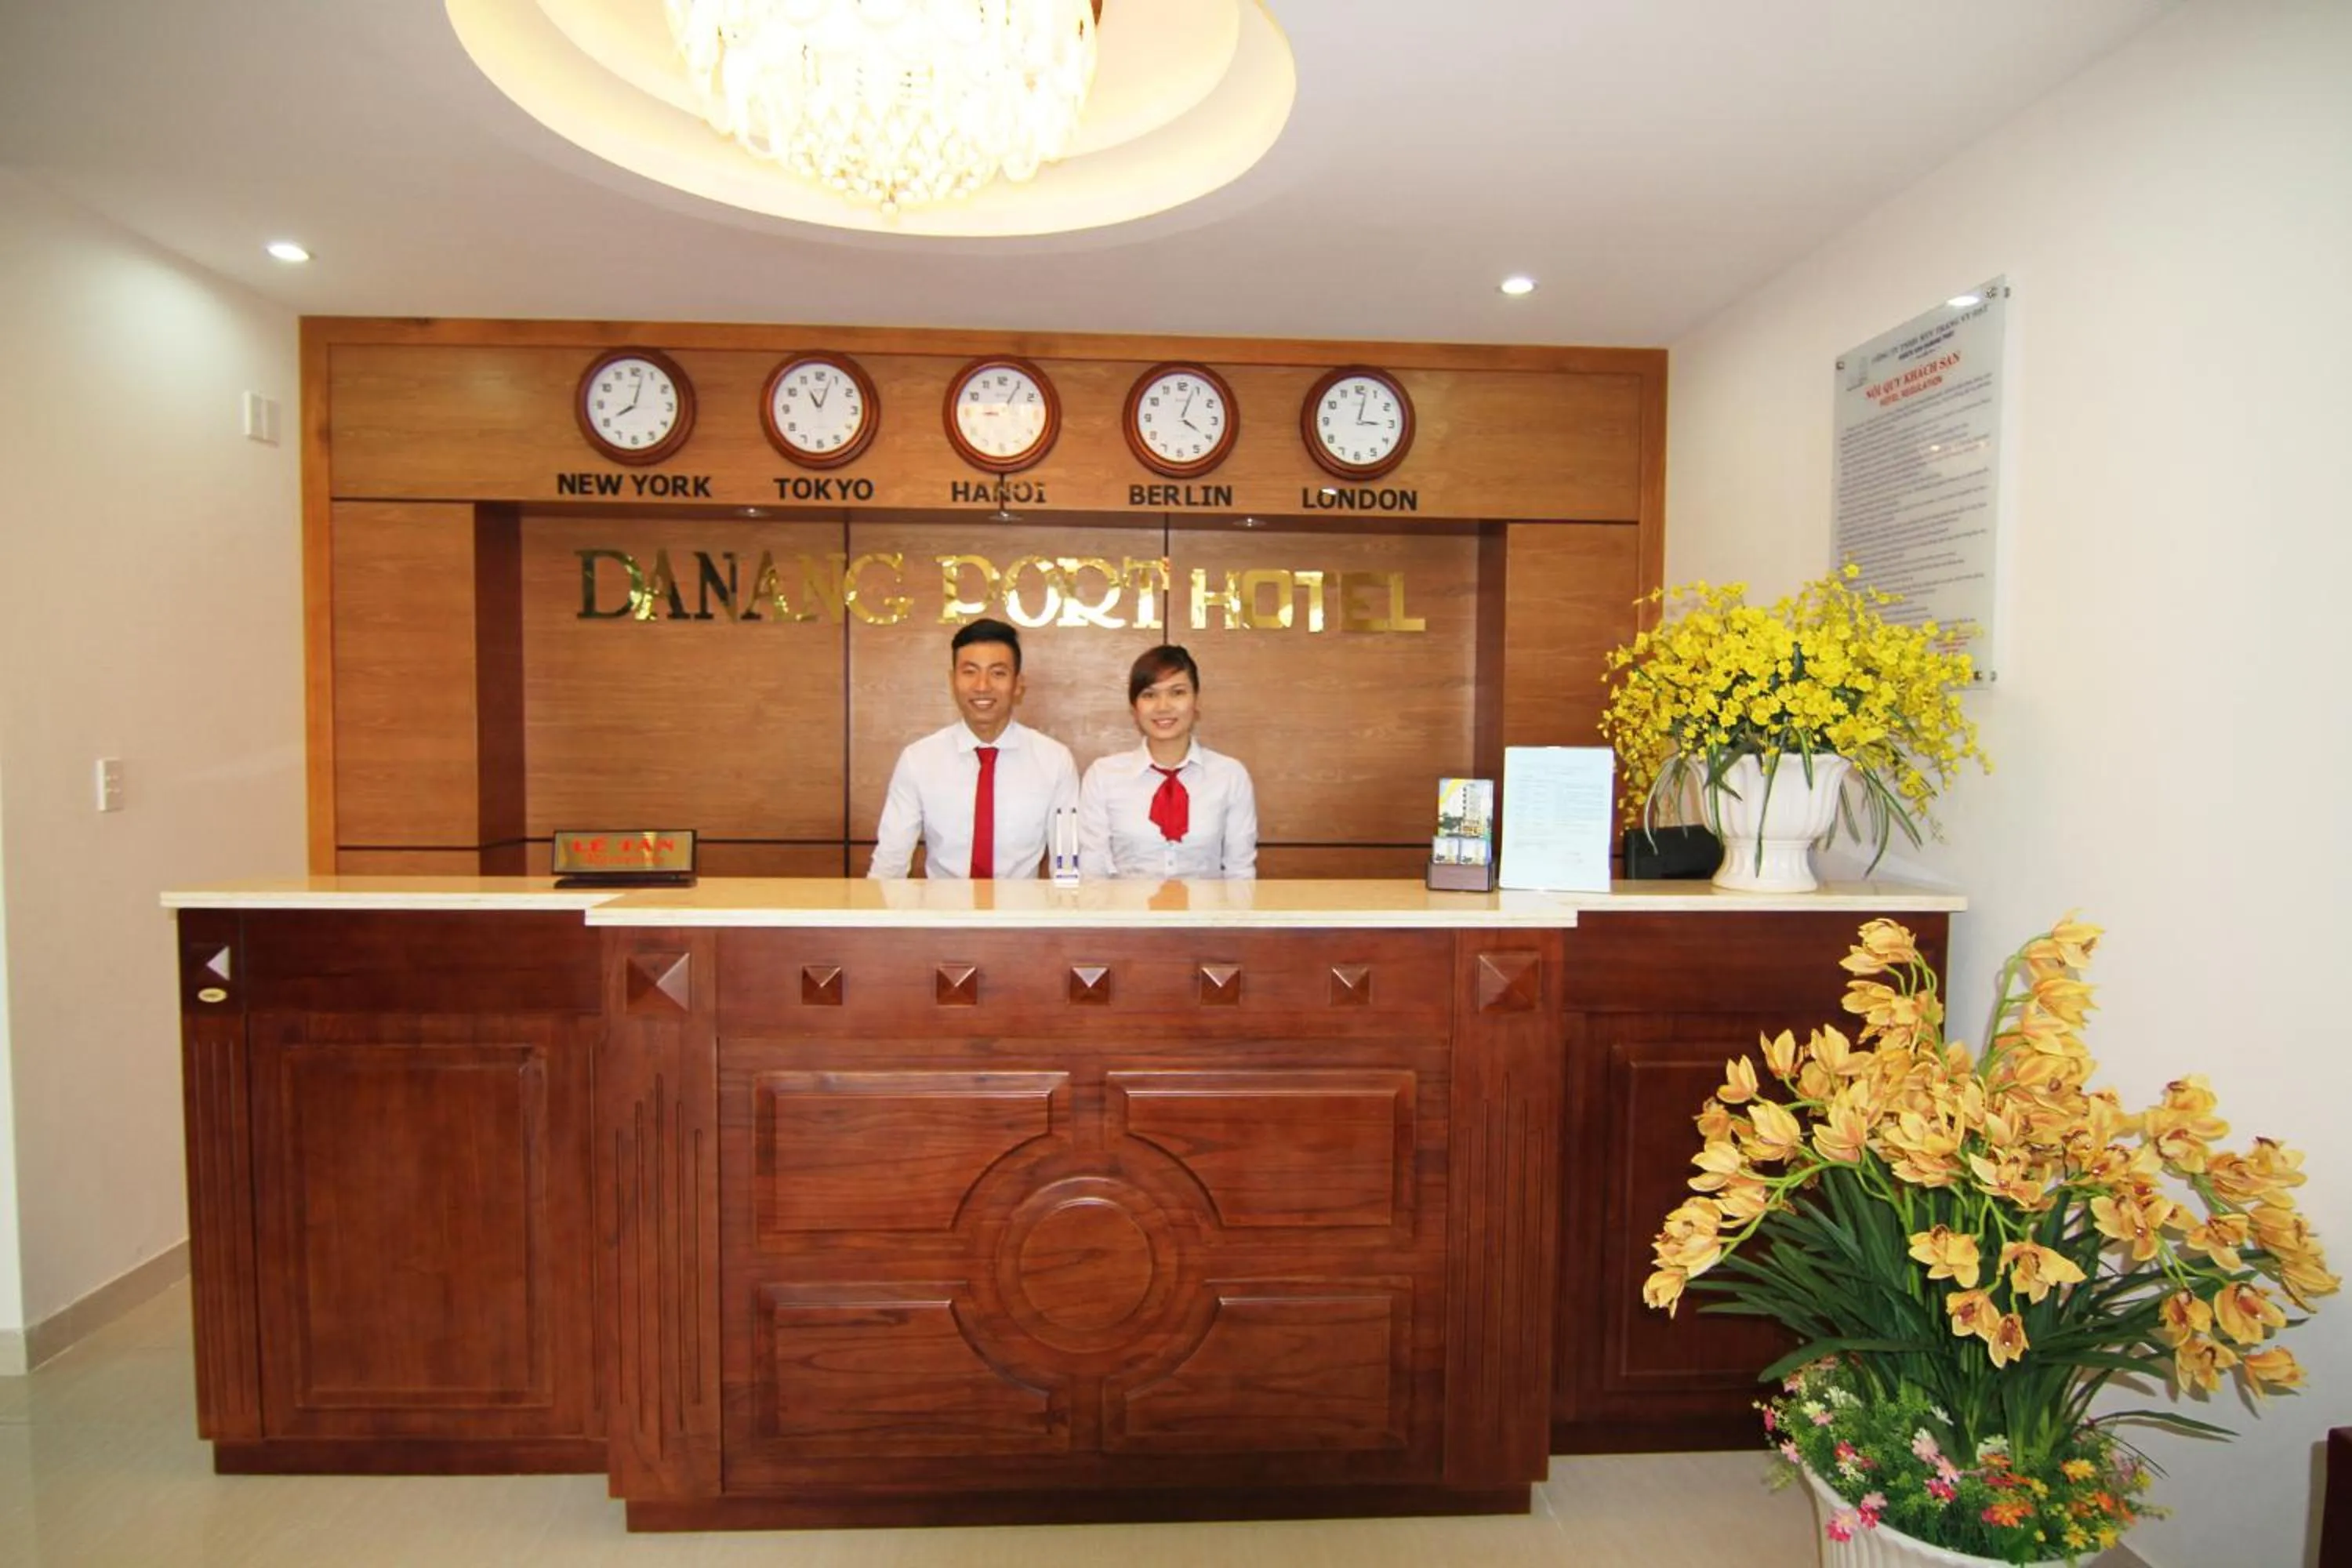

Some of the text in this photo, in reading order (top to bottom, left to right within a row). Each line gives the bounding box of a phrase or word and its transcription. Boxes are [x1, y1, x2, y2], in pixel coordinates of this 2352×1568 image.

[557, 473, 713, 499] NEW YORK
[774, 477, 874, 500] TOKYO
[952, 481, 1046, 503] HANOI
[1128, 485, 1233, 506] BERLIN
[1301, 488, 1417, 510] LONDON
[575, 550, 1426, 632] DANANG PORT HOTEL
